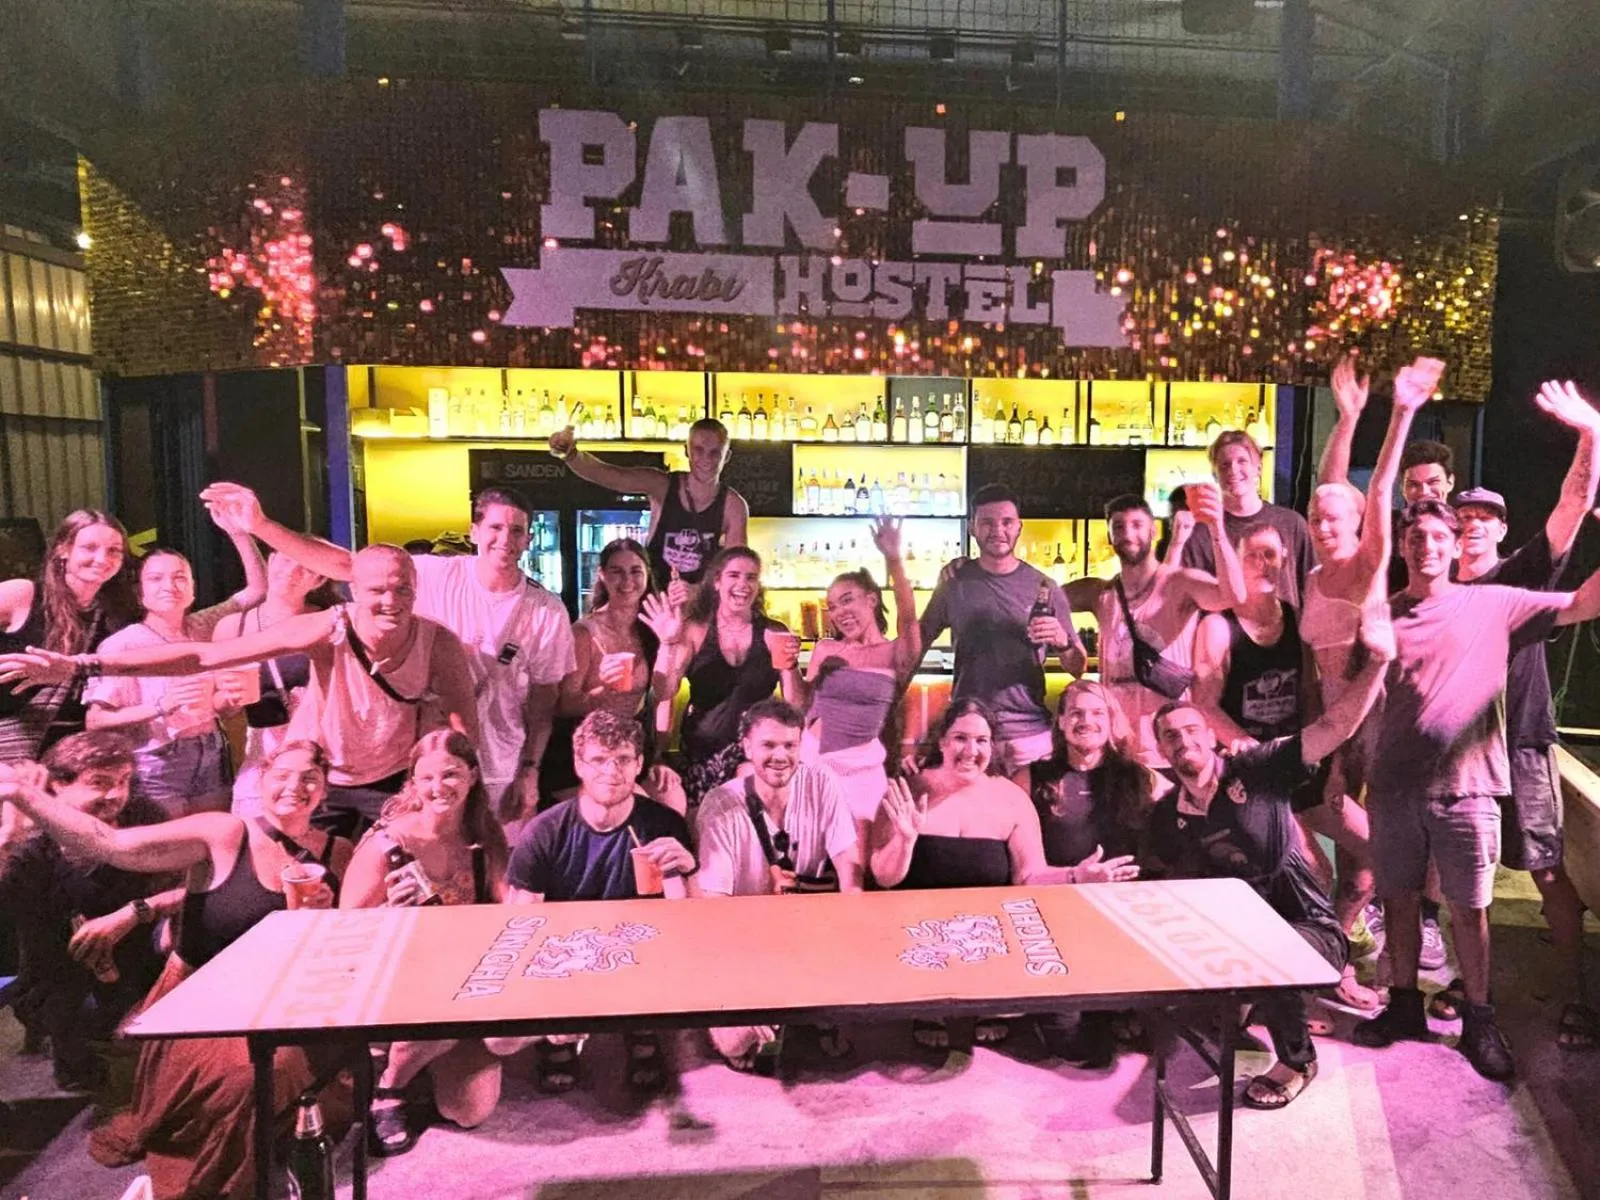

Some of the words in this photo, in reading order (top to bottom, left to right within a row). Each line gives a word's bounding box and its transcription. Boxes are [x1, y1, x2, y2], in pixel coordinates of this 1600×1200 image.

[609, 256, 748, 305] Krabi
[780, 255, 1051, 325] HOSTEL
[504, 463, 566, 479] SANDEN
[453, 915, 547, 1001] SINGHA
[1001, 898, 1069, 977] SINGHA
